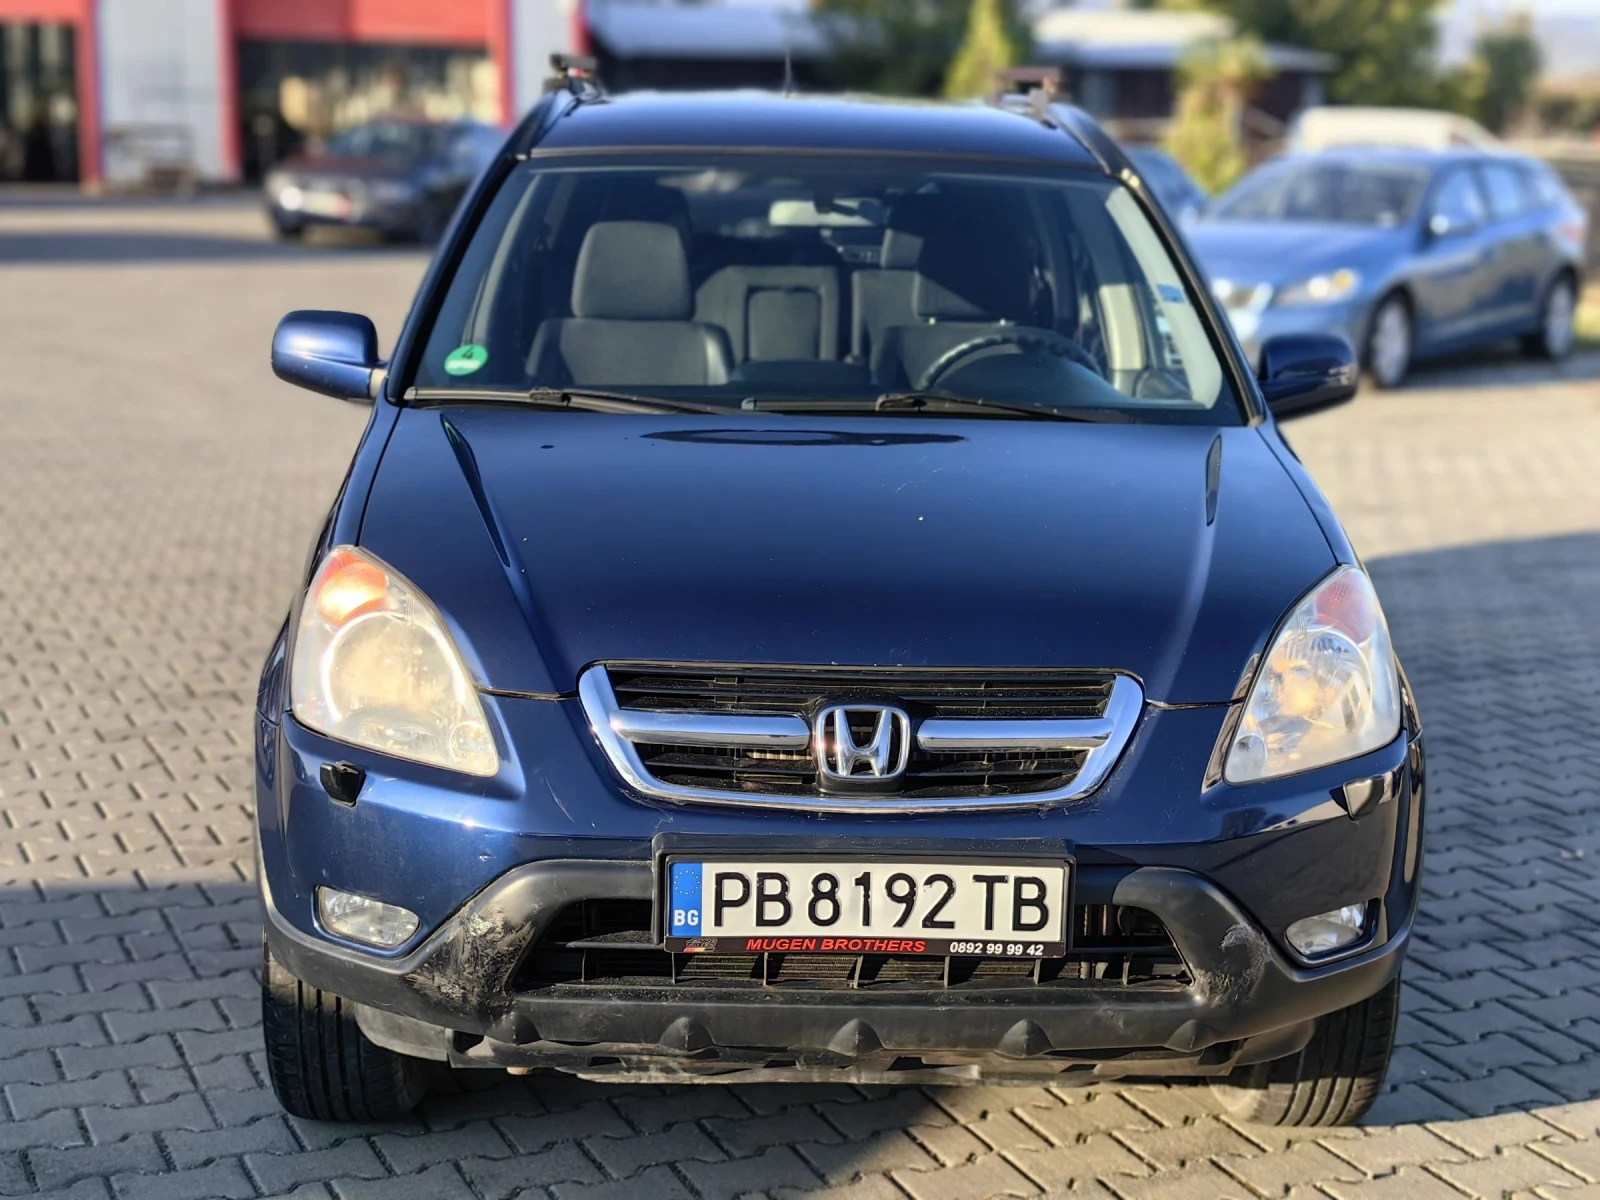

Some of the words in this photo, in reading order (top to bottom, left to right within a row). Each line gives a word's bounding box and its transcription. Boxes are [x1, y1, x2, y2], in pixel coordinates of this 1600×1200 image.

[713, 871, 792, 928] PB
[807, 871, 957, 930] 8192
[971, 874, 1050, 932] TB
[673, 908, 700, 927] BG
[745, 937, 818, 951] MUGEN
[820, 937, 927, 953] BROTHERS
[949, 941, 983, 954] 0892
[985, 943, 1003, 955] 99
[1006, 943, 1024, 956] 99
[1026, 944, 1045, 956] 42
